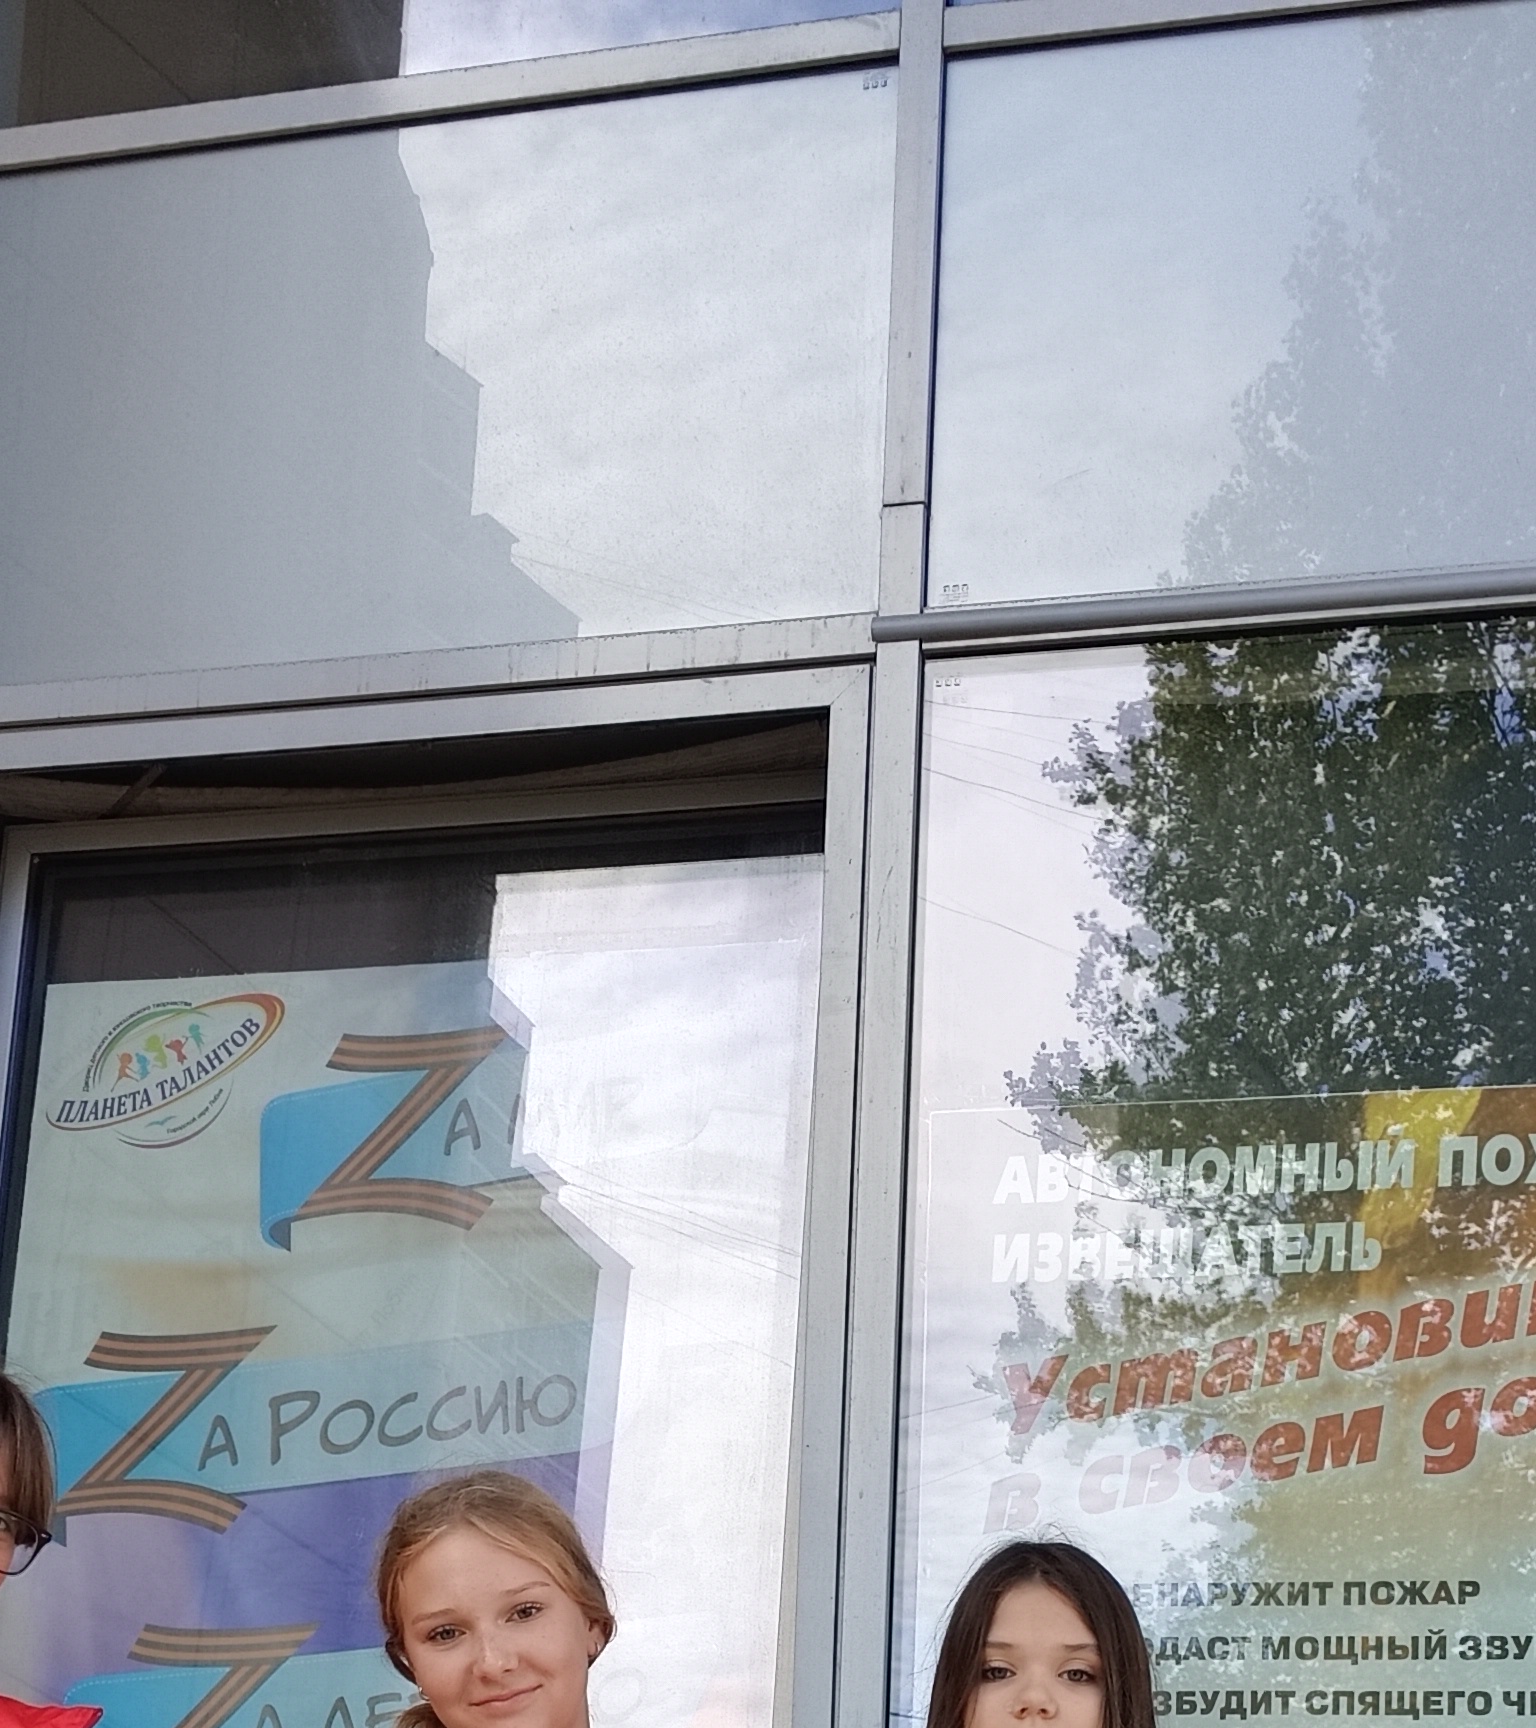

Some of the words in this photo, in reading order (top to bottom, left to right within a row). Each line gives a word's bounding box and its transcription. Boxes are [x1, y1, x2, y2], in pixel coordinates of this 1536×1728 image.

[55, 1087, 152, 1123] ПЛАНЕТА
[155, 1017, 261, 1101] ТАЛАНТОВ
[993, 1124, 1415, 1204] АВТОНОМНЫЙ
[991, 1221, 1383, 1283] ИЗВЕЩАТЕЛЬ
[270, 1372, 578, 1464] РОССИЮ
[1078, 1405, 1384, 1515] своем
[1133, 1580, 1334, 1607] БНАРУЖИТ
[1343, 1580, 1481, 1607] ПОЖАР
[1262, 1628, 1448, 1665] МОЩНЫЙ
[1153, 1690, 1296, 1721] ЗБУДИТ
[1305, 1690, 1492, 1721] СПЯЩЕГО
